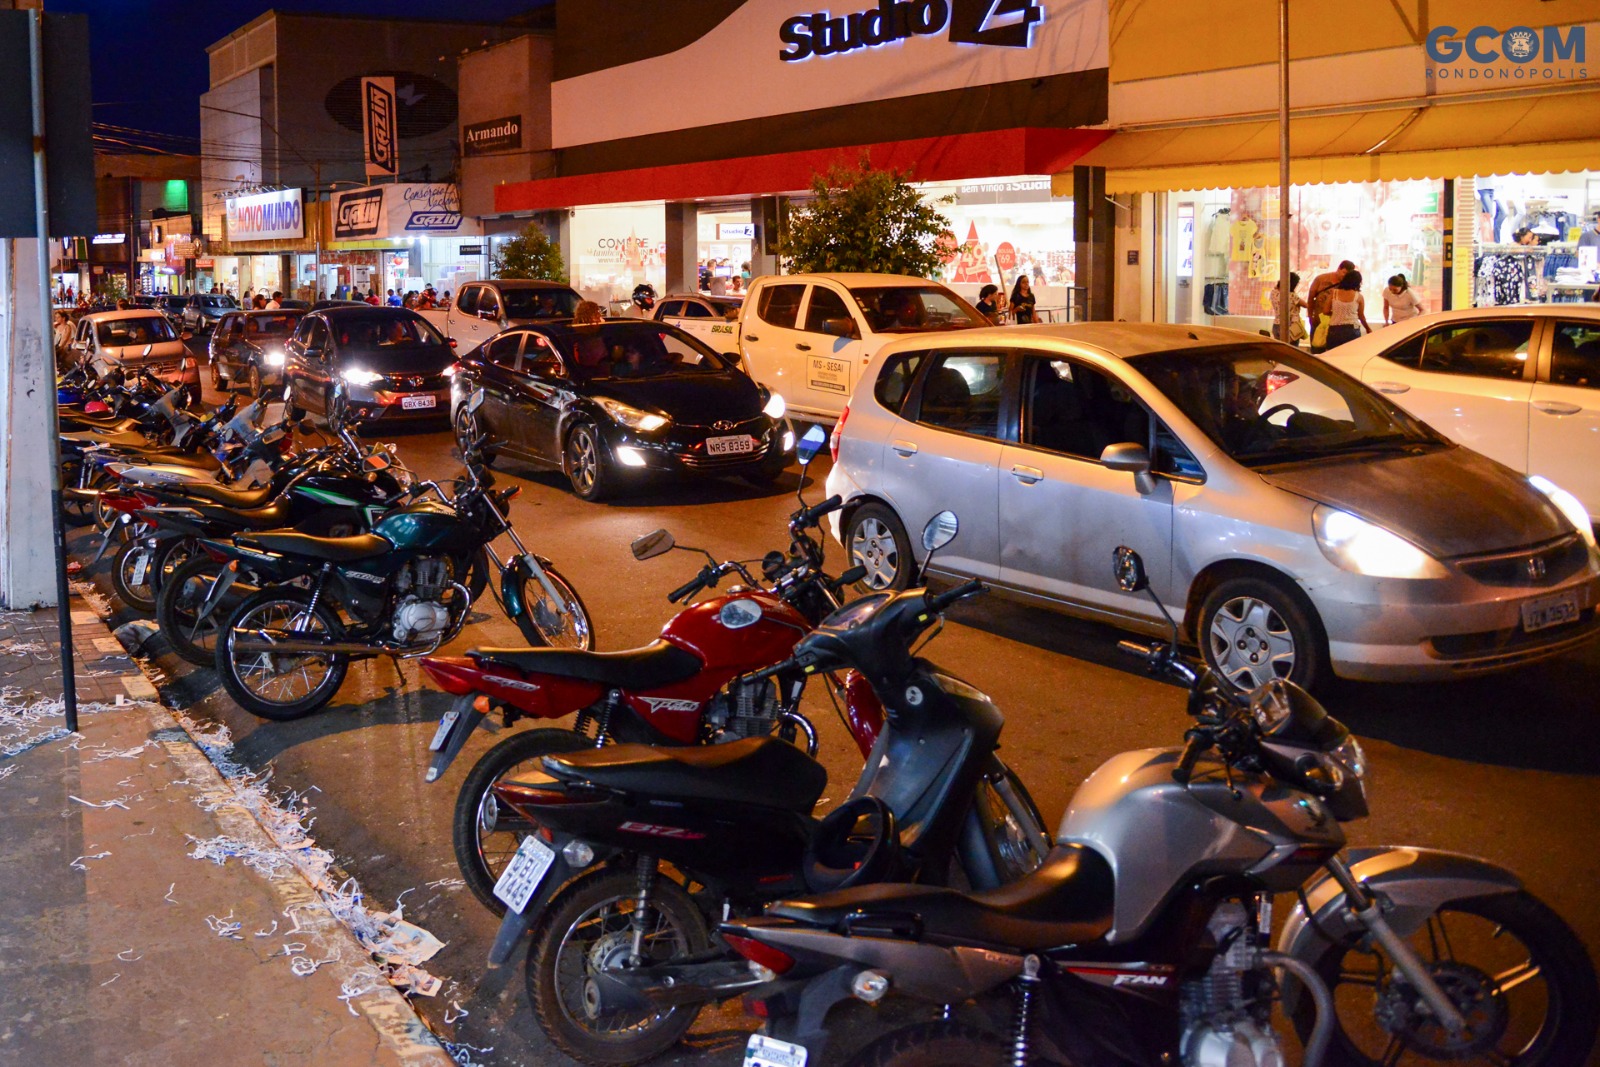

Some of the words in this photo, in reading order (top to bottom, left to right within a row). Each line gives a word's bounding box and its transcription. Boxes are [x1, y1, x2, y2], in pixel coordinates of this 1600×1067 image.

[466, 121, 518, 142] Armando
[239, 199, 300, 232] NOVOMUNDO
[411, 213, 462, 227] GAZIN
[711, 325, 733, 334] BRASIL
[813, 360, 822, 369] MS
[710, 443, 727, 452] NRS
[729, 441, 750, 451] 8359
[1113, 974, 1167, 985] FAN
